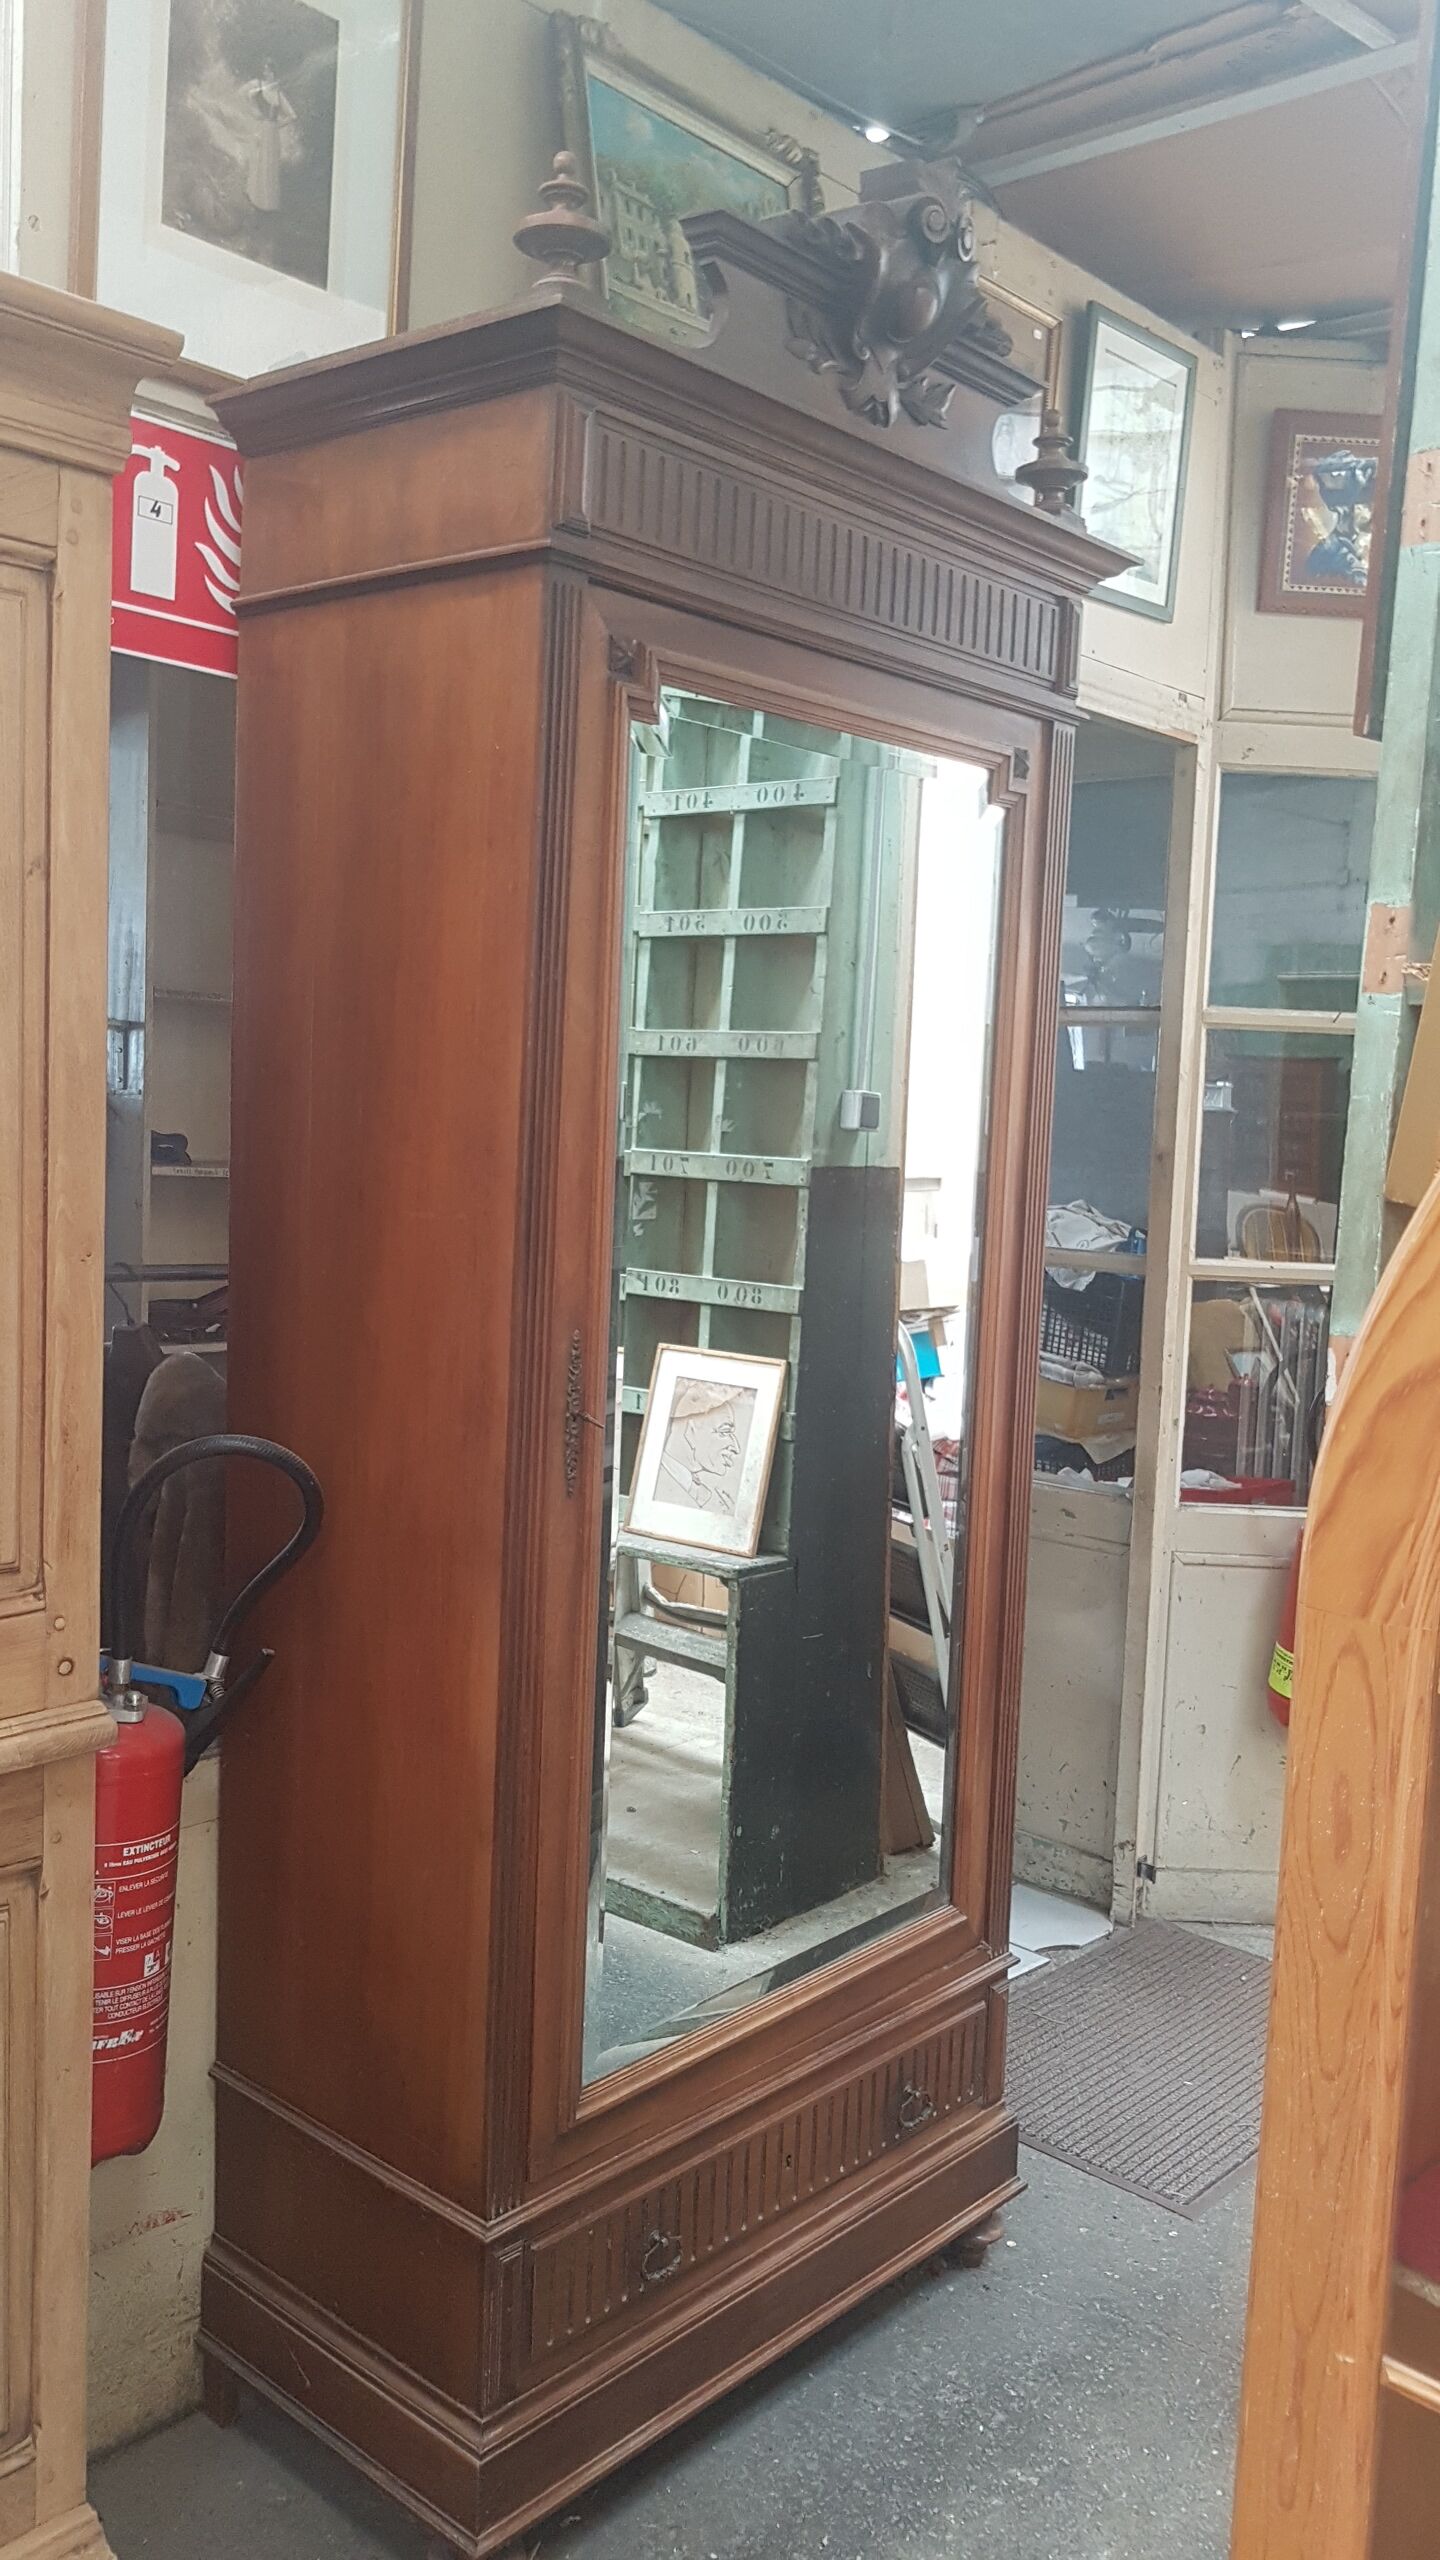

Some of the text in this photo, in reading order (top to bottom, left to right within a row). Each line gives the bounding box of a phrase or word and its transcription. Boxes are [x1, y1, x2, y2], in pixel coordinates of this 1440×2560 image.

[150, 500, 161, 518] 4
[123, 1834, 171, 1857] EXTINCTEUR
[118, 1881, 143, 1893] ENLEVER
[117, 1909, 135, 1919] LEVER
[135, 1907, 142, 1915] LE
[115, 1936, 133, 1945] VISER
[115, 1943, 140, 1954] PRESSER
